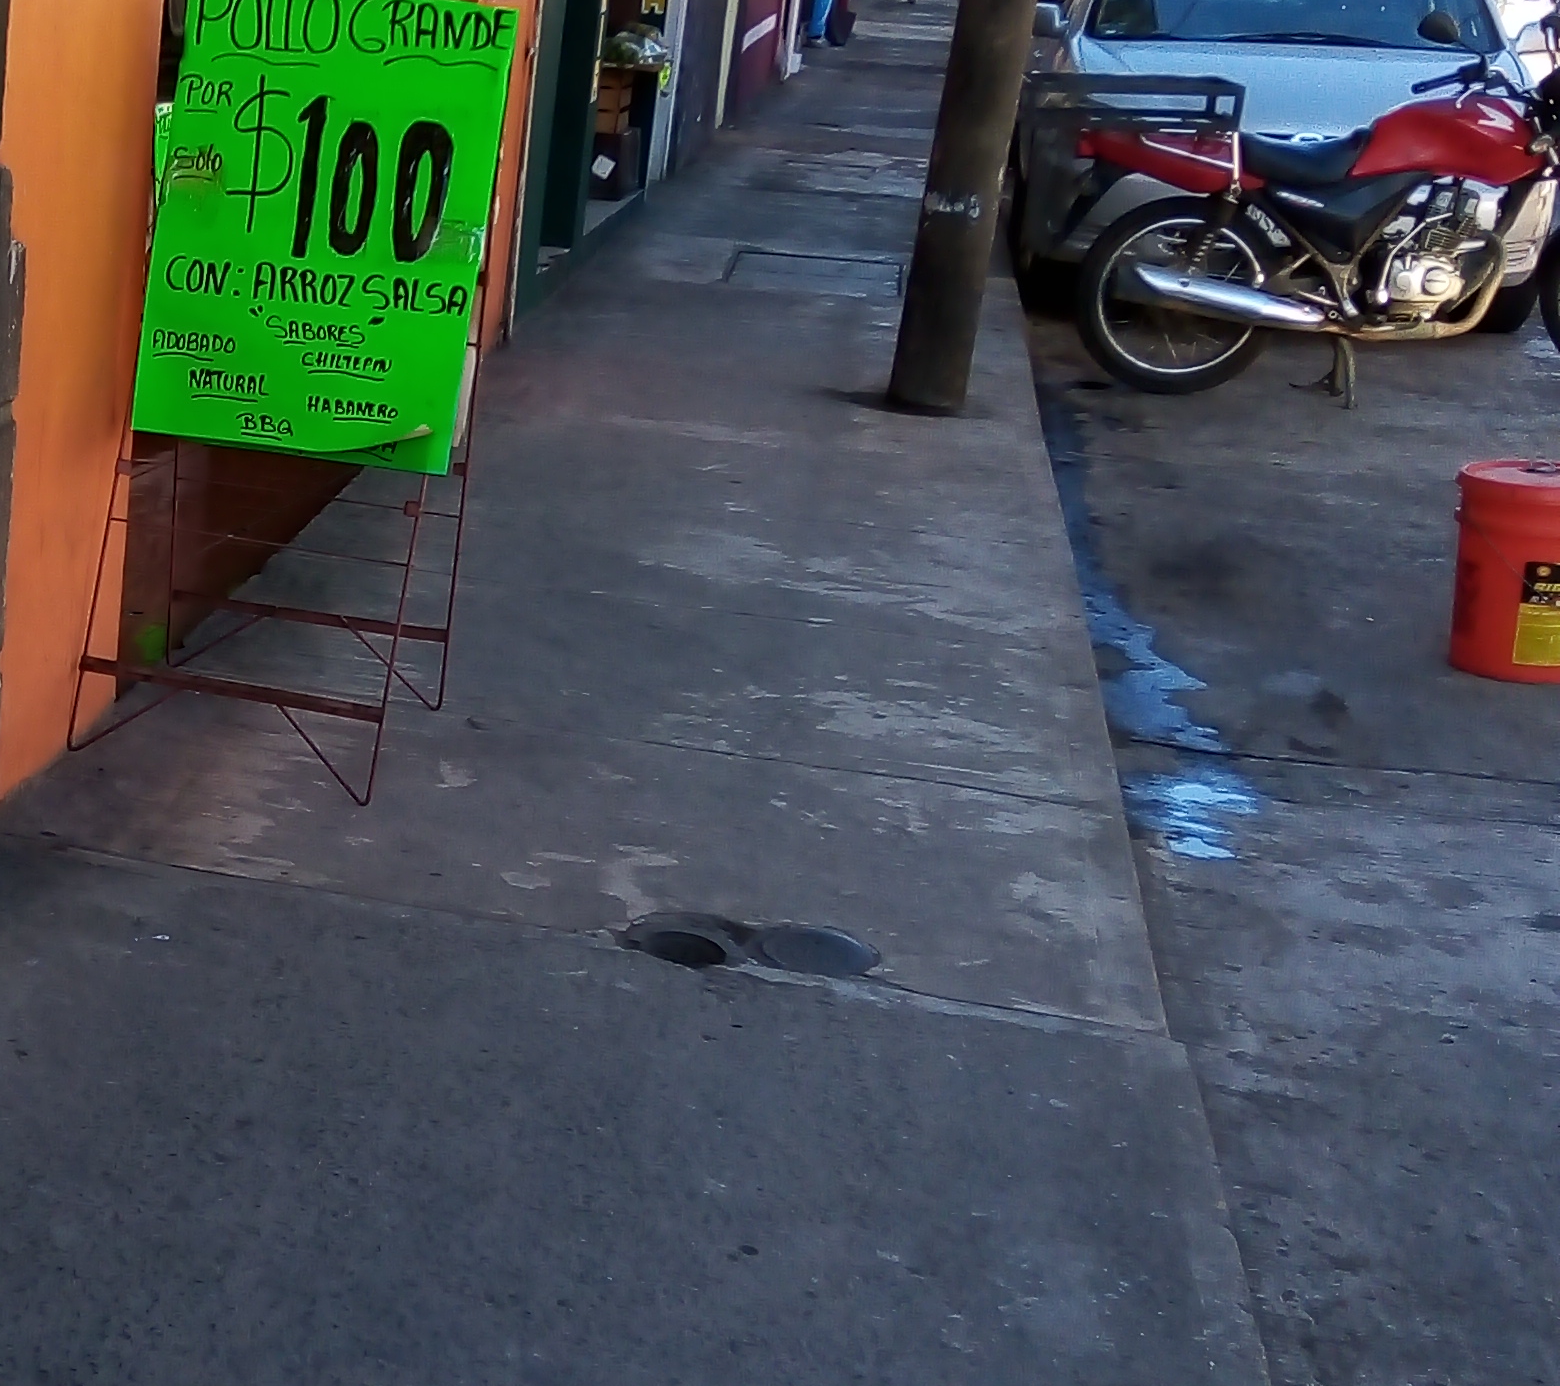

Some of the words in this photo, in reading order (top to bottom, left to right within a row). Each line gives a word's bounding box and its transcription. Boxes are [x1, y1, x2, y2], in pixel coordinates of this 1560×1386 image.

[179, 72, 234, 107] POR
[225, 73, 455, 264] $100
[164, 253, 245, 298] CON:
[252, 262, 356, 308] ARROZ
[361, 273, 468, 318] SALSA
[152, 328, 237, 355] ADOBADO
[189, 368, 270, 397] NATURAL
[306, 394, 399, 420] HABANERO
[236, 412, 294, 438] BBQ
